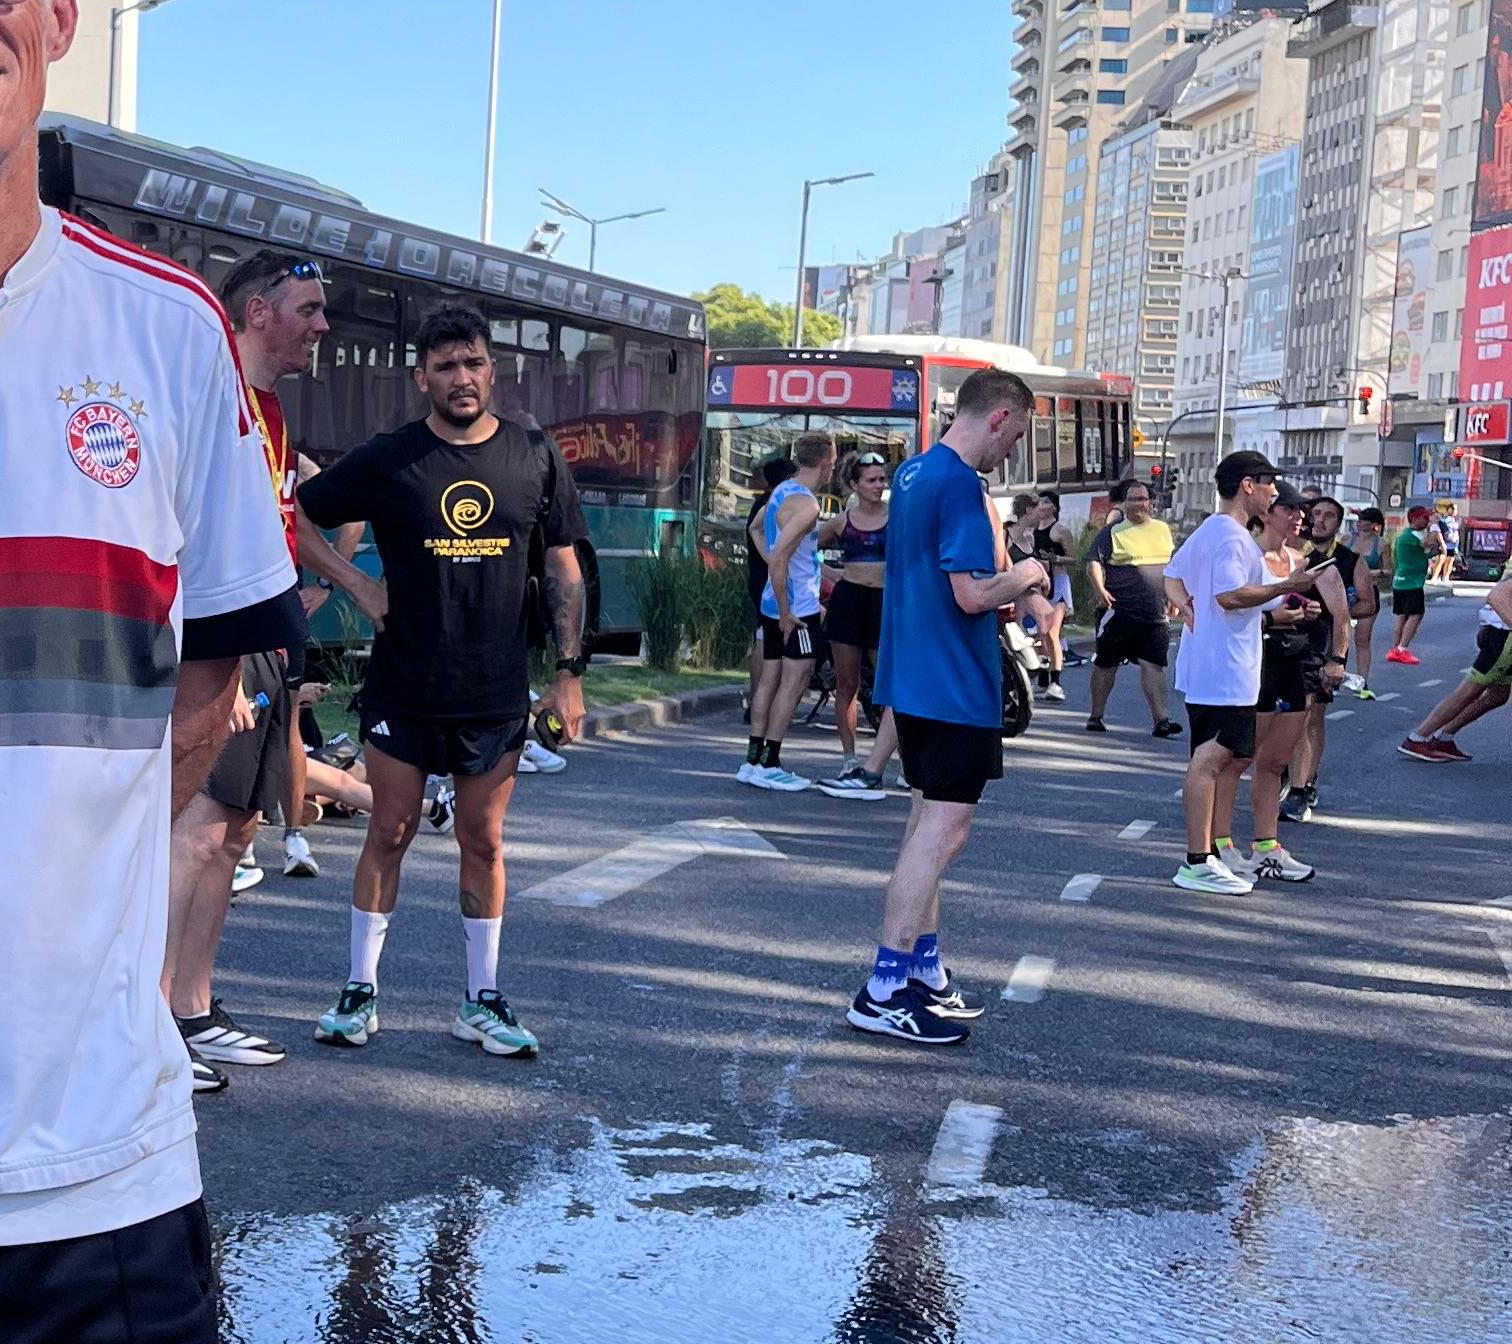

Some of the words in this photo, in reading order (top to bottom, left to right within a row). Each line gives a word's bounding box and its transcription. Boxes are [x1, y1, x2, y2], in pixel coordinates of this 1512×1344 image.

[133, 168, 352, 254] WILDE
[364, 230, 440, 280] 10
[446, 249, 672, 331] RECOLETA
[1478, 253, 1512, 289] KFC
[766, 369, 852, 404] 100
[70, 416, 88, 438] FC
[85, 407, 138, 449] BAYERN
[1466, 413, 1490, 435] KFC
[424, 538, 451, 548] SAN
[451, 537, 511, 548] SILVESTRE
